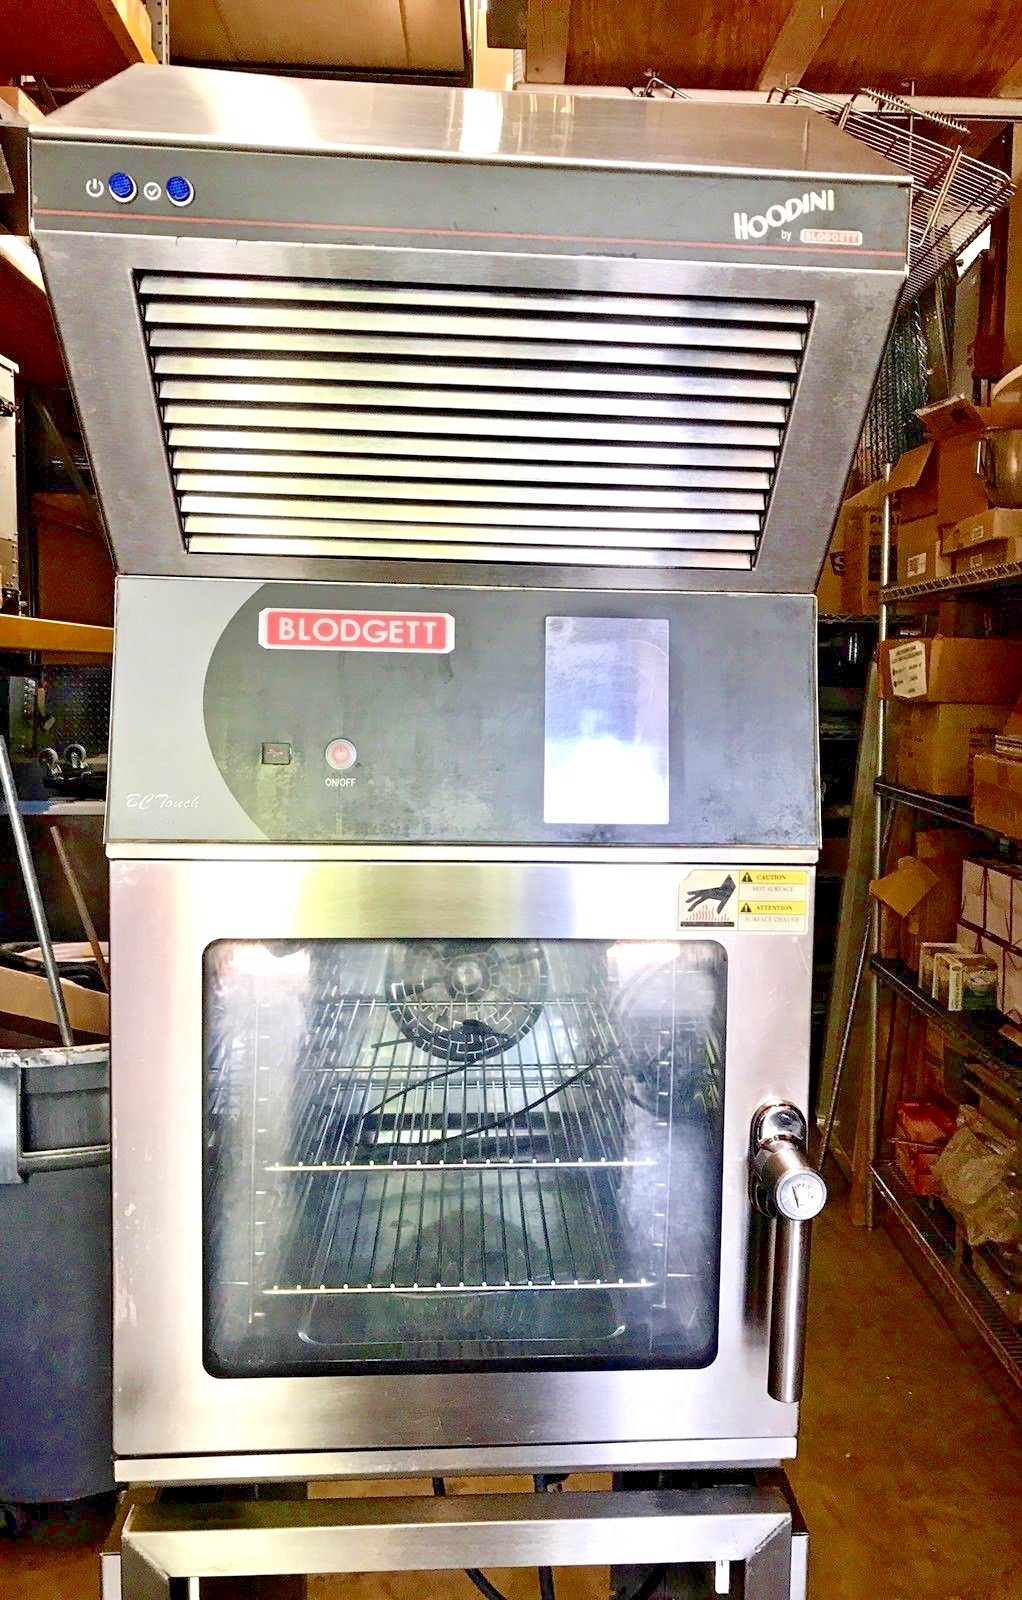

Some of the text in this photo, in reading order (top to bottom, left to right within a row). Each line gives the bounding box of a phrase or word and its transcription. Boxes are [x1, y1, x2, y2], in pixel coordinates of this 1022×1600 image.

[733, 189, 835, 240] HOODINI
[781, 229, 859, 244] by BLODGETT
[278, 616, 437, 644] BLODGETT
[325, 777, 356, 788] ON/OFF
[125, 793, 200, 810] BC Touch
